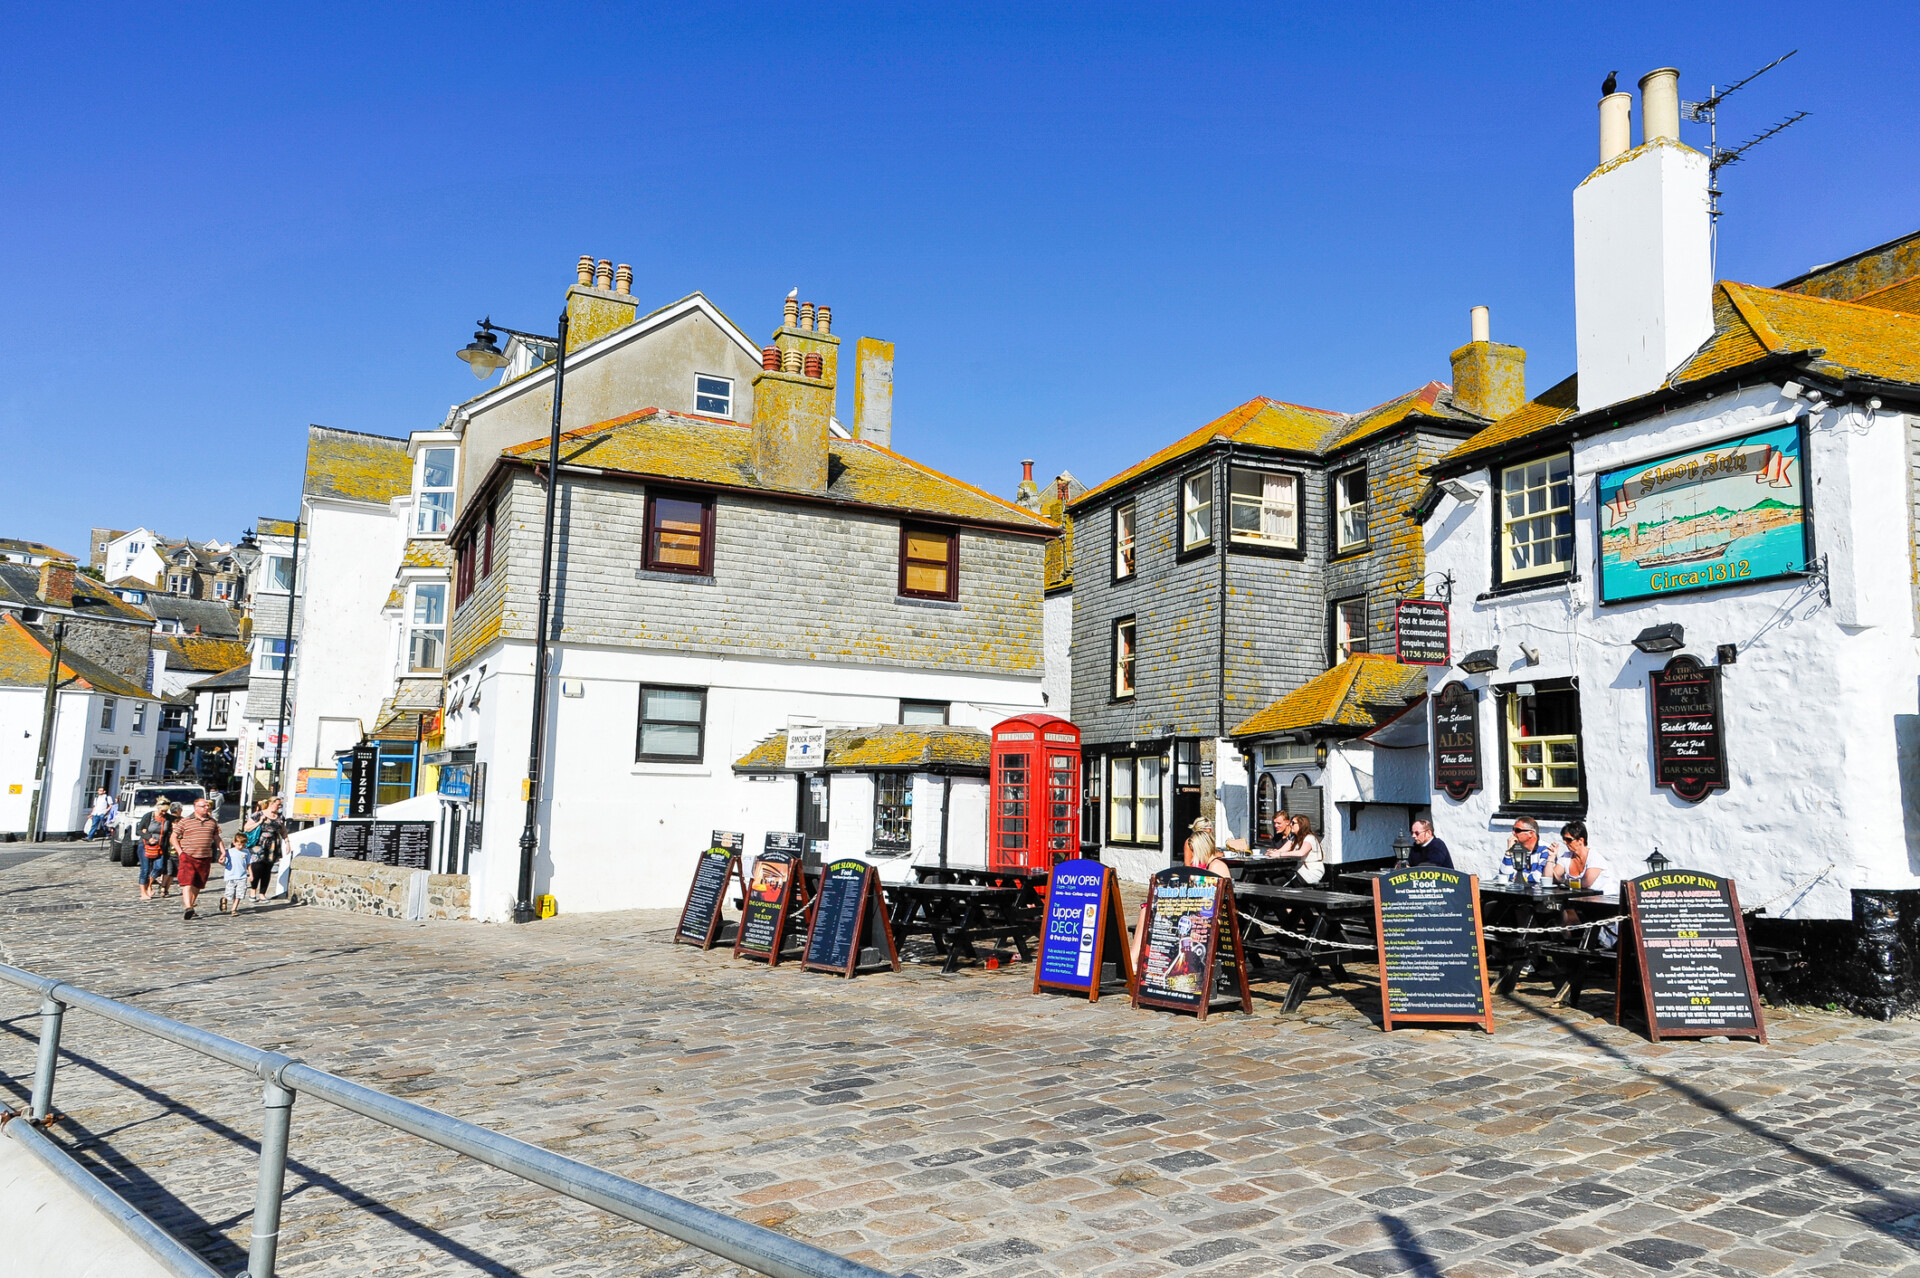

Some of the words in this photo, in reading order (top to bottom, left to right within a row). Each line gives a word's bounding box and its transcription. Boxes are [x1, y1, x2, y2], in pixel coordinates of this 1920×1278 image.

[1640, 460, 1698, 495] Sloop
[1702, 452, 1748, 476] Inn
[1419, 618, 1446, 626] Breakfast
[1400, 628, 1447, 637] Accommodation
[1670, 687, 1699, 696] MEALS
[1660, 703, 1712, 712] SANDWICHES
[1437, 715, 1448, 724] Fine
[1450, 714, 1472, 722] Selection
[1452, 724, 1457, 733] of
[1661, 723, 1686, 732] Basket
[1687, 722, 1712, 730] Meals
[1439, 732, 1473, 748] ALES
[1441, 755, 1457, 763] Three
[1458, 754, 1472, 762] Bars
[358, 760, 368, 813] PIZZAS
[830, 863, 840, 872] THE
[856, 864, 865, 873] INN
[1057, 875, 1078, 884] NOW
[1078, 875, 1100, 886] OPEN
[1388, 874, 1408, 886] THE
[1409, 871, 1441, 881] SLOOP
[1442, 873, 1459, 885] INN
[1639, 877, 1662, 891] THE
[1662, 875, 1698, 885] SLOOP
[1700, 877, 1718, 889] INN
[1412, 880, 1436, 888] Food
[1158, 887, 1179, 897] Take
[1179, 884, 1187, 897] it
[1188, 886, 1217, 898] away!
[1053, 907, 1082, 920] upper
[1050, 920, 1080, 935] DECK
